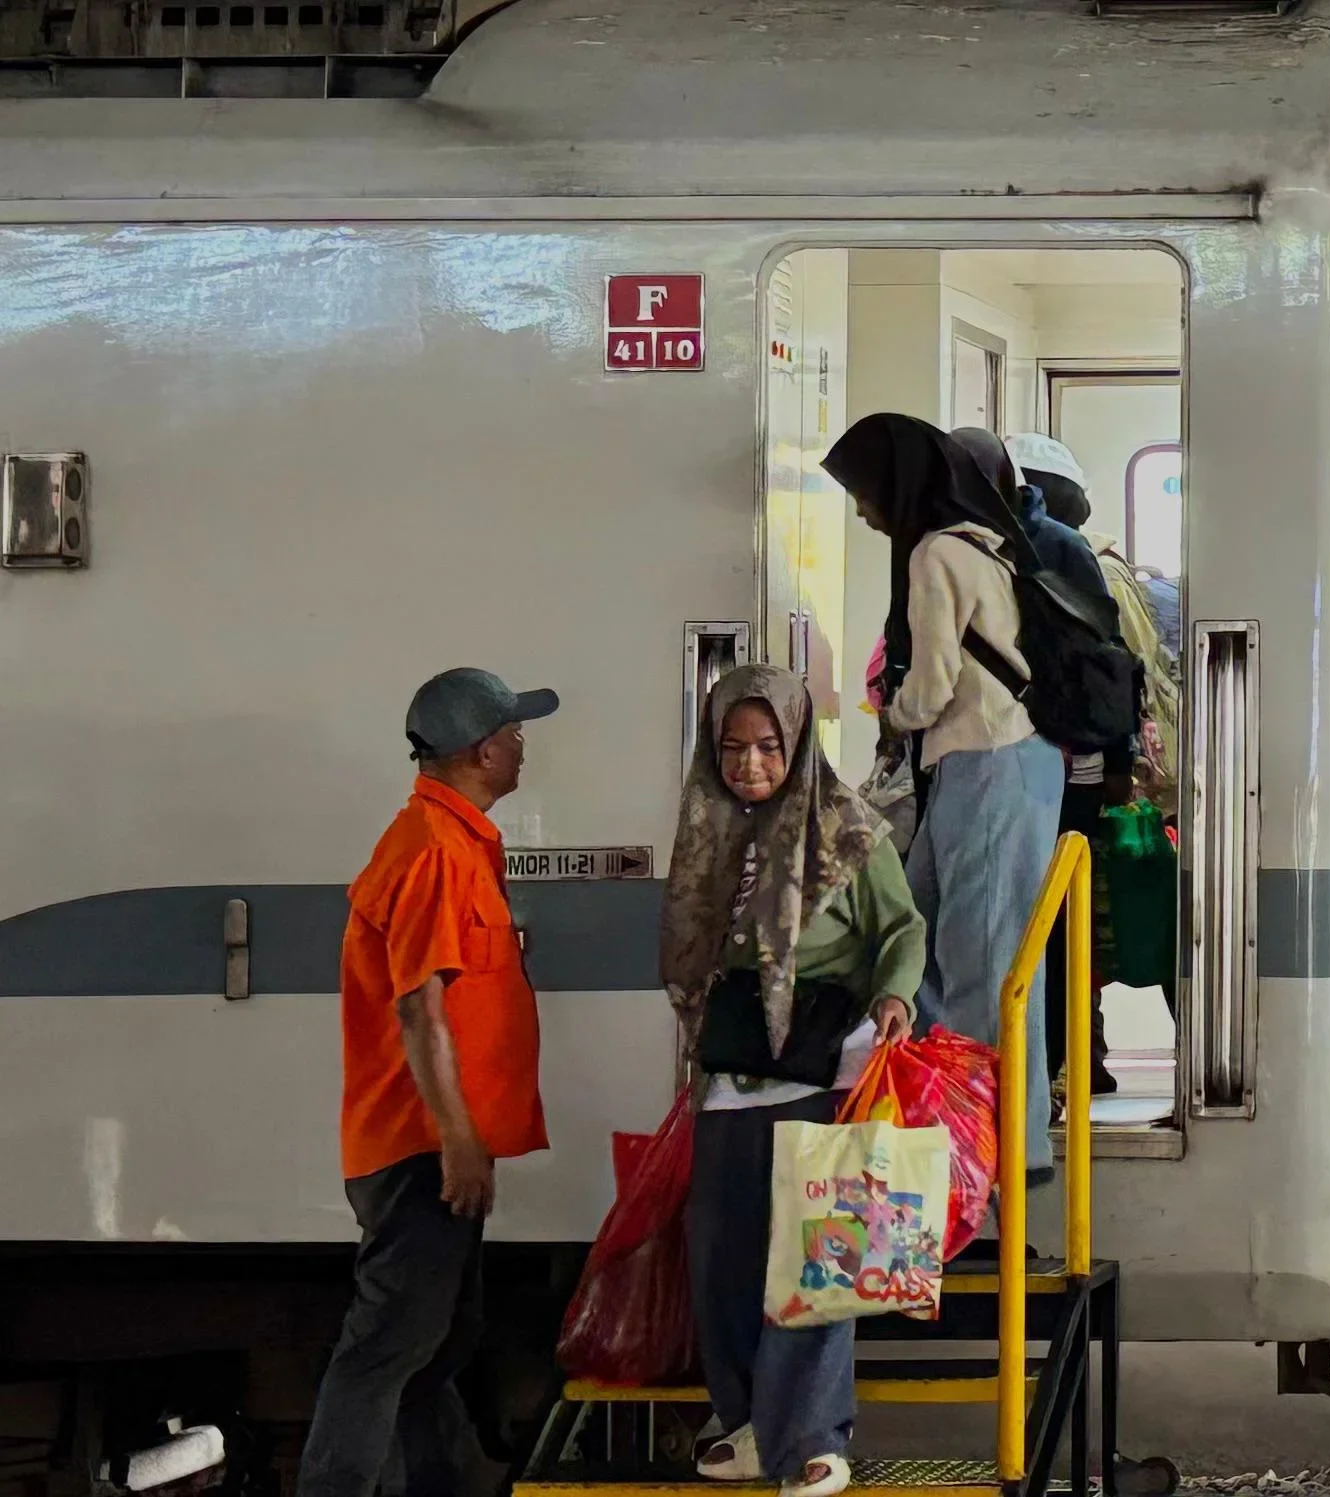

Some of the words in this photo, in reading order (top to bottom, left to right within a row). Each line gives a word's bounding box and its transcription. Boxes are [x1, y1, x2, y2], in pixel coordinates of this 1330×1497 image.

[636, 285, 669, 321] F
[613, 339, 645, 361] 41
[663, 339, 695, 361] 10
[504, 855, 550, 876] MOR
